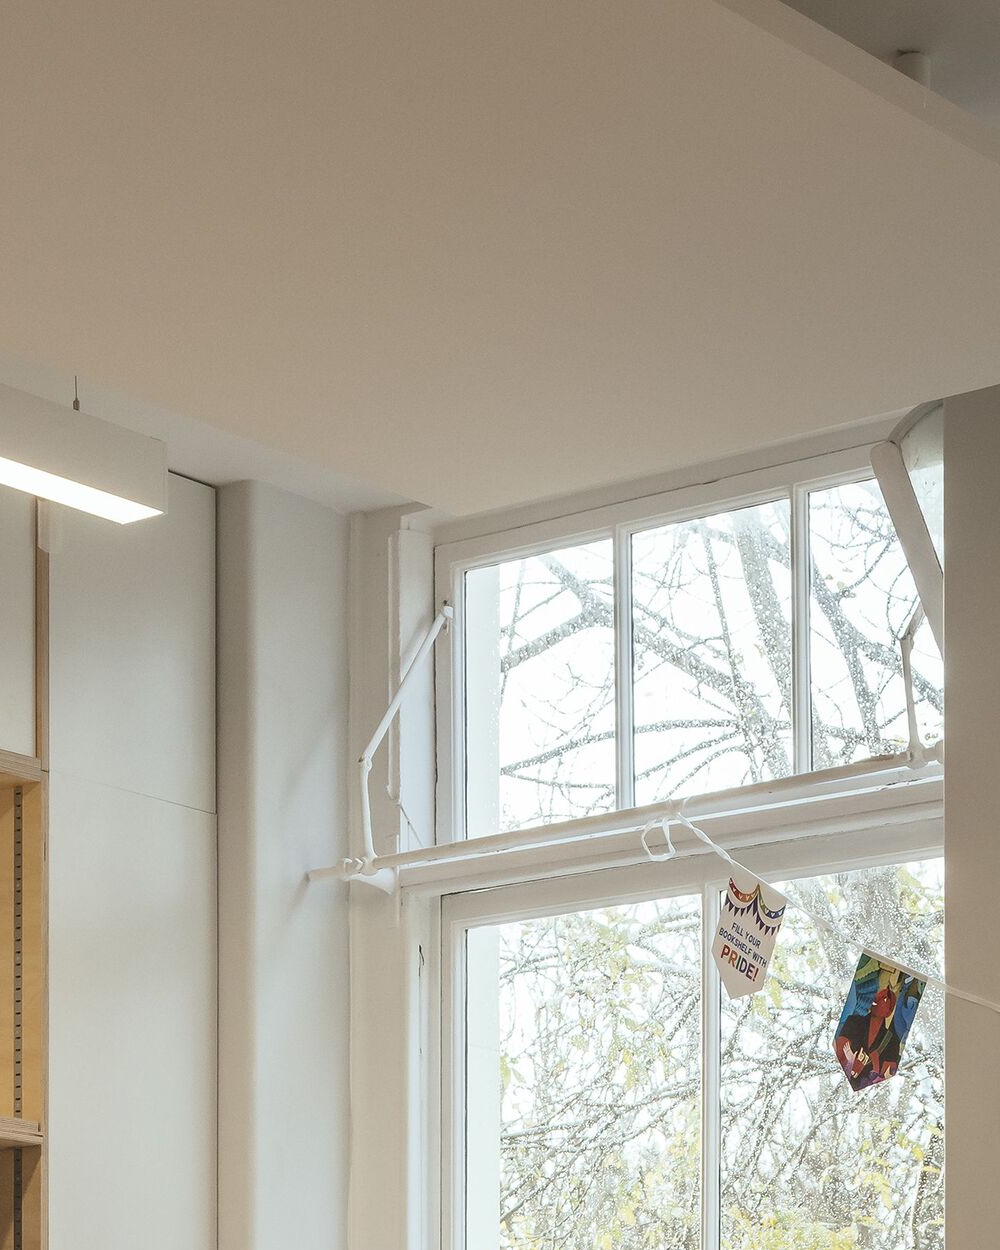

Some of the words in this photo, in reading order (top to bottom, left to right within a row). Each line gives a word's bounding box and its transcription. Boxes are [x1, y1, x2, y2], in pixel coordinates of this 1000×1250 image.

[718, 927, 753, 955] BOOKSHELF
[752, 951, 768, 968] WITH
[731, 922, 744, 937] FILL
[745, 931, 762, 949] YOUR
[720, 944, 760, 982] PRIDE!
